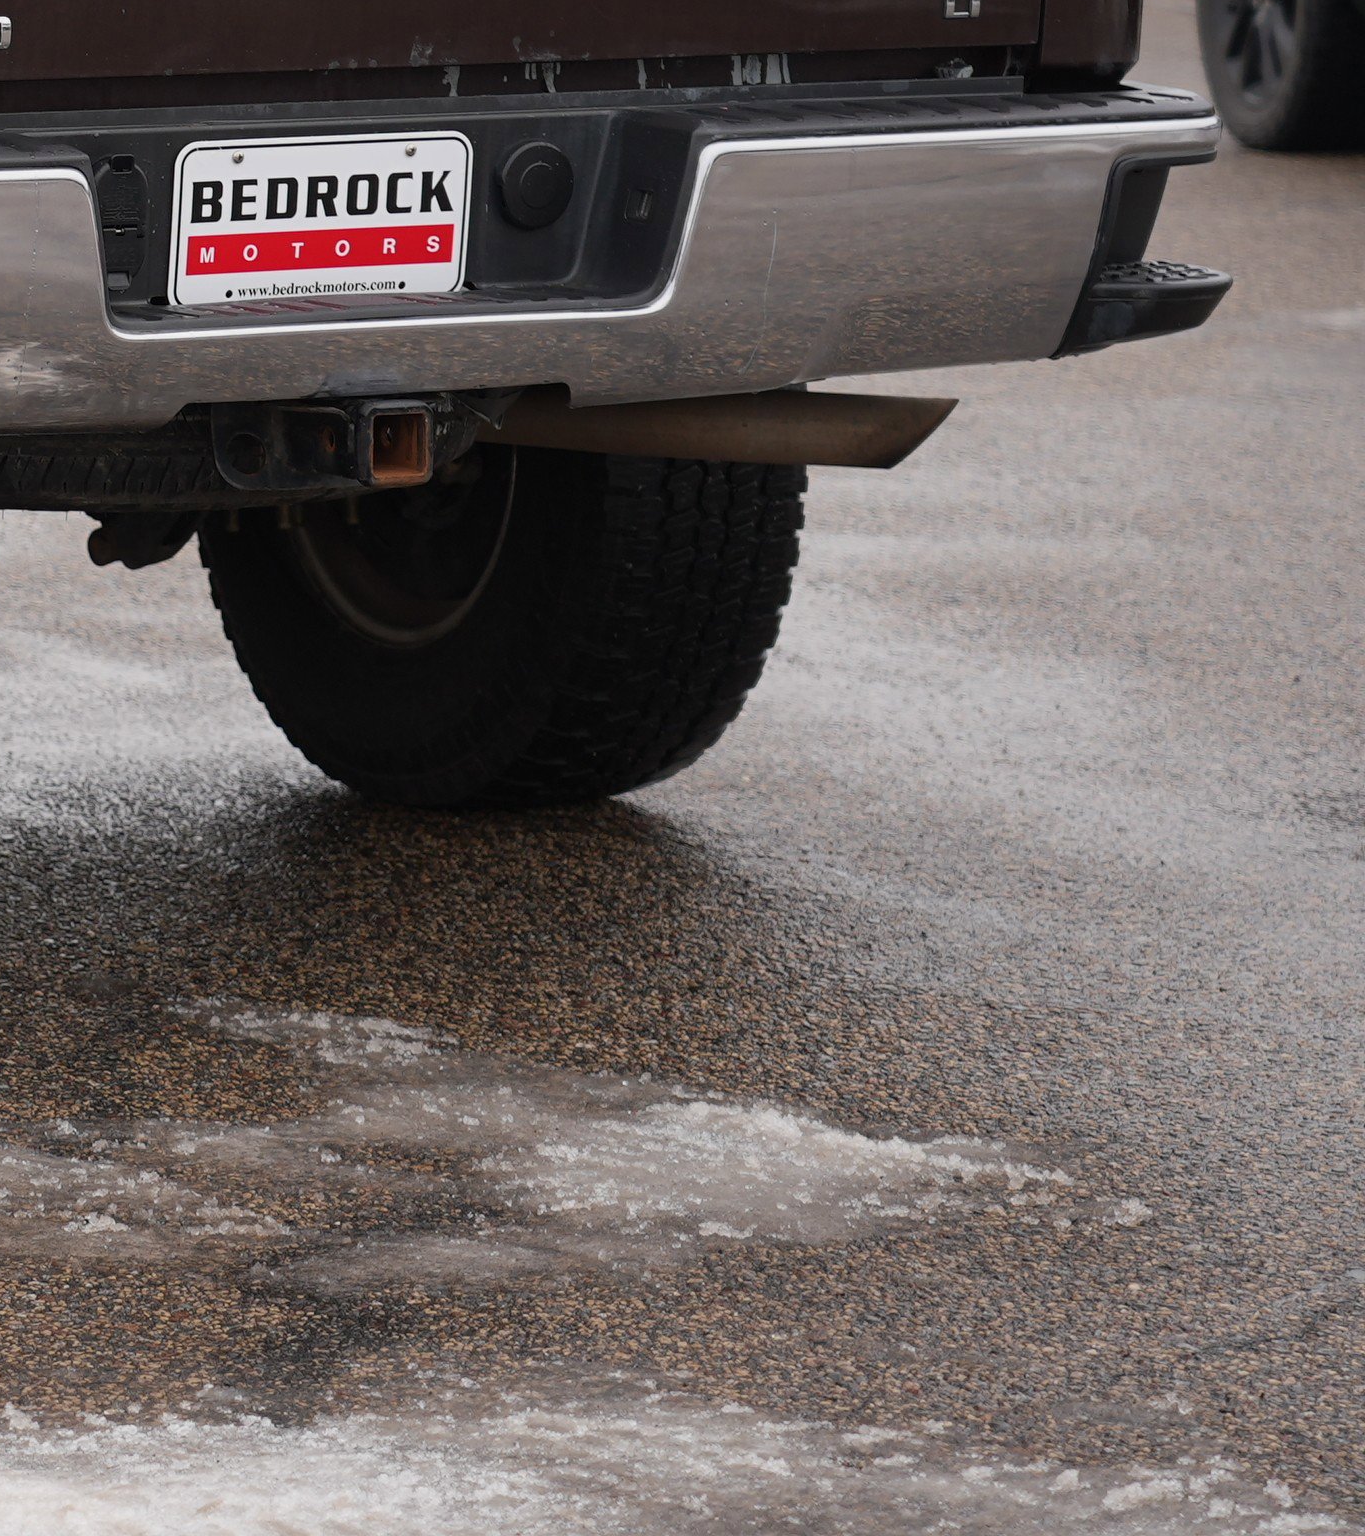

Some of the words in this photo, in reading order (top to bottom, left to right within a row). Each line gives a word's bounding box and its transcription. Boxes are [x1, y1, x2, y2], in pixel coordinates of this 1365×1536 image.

[190, 170, 454, 224] BEDROCK
[199, 235, 441, 264] MOTORS
[237, 278, 397, 298] www.bedrockmotors.com
